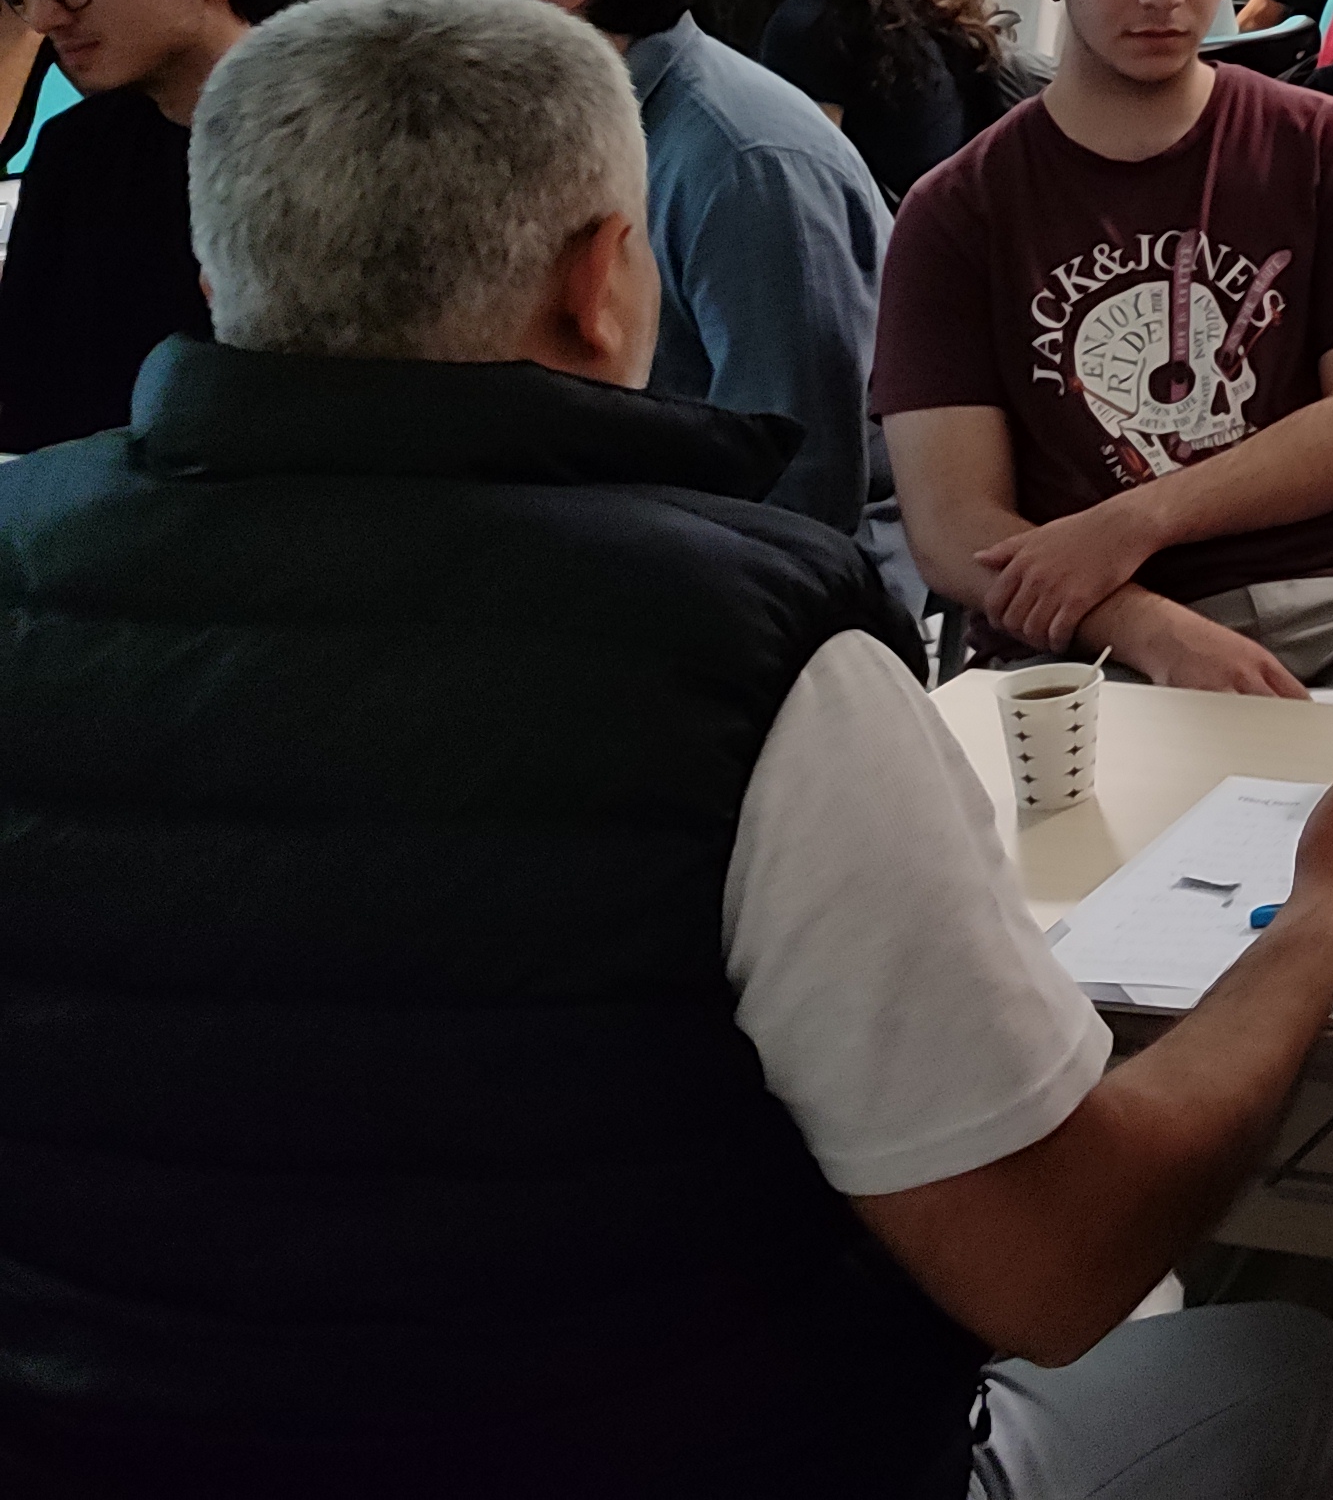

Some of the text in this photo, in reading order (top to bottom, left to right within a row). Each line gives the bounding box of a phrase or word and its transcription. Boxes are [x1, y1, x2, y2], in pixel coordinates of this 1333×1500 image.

[1031, 229, 1287, 397] JACK&JONES
[1082, 291, 1145, 381] ENJOY
[1107, 320, 1164, 396] RIDE
[1101, 444, 1136, 486] SINC
